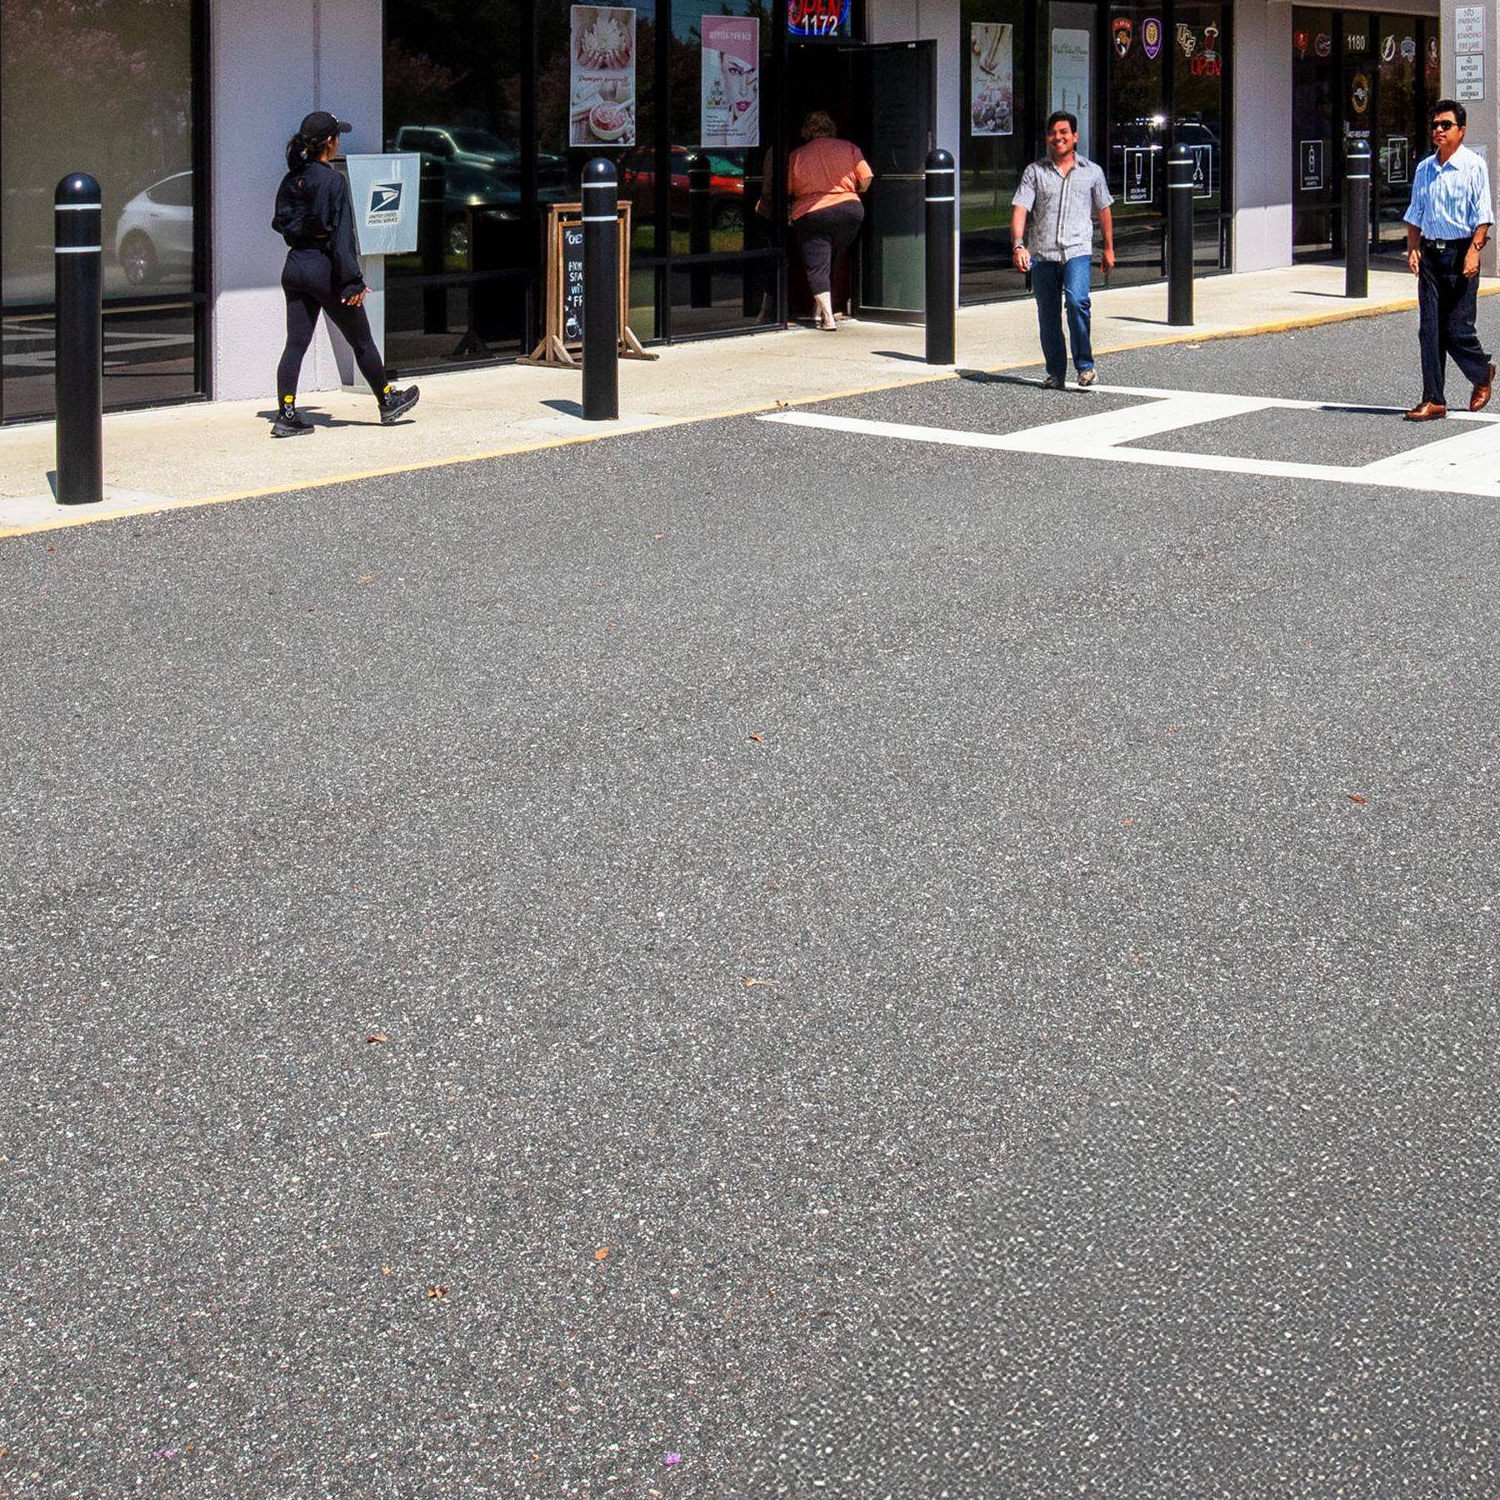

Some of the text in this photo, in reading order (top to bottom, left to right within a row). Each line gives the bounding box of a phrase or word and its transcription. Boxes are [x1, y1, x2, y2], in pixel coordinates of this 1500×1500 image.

[1464, 9, 1475, 17] NO
[802, 14, 838, 36] 1172
[1347, 34, 1367, 51] 1180
